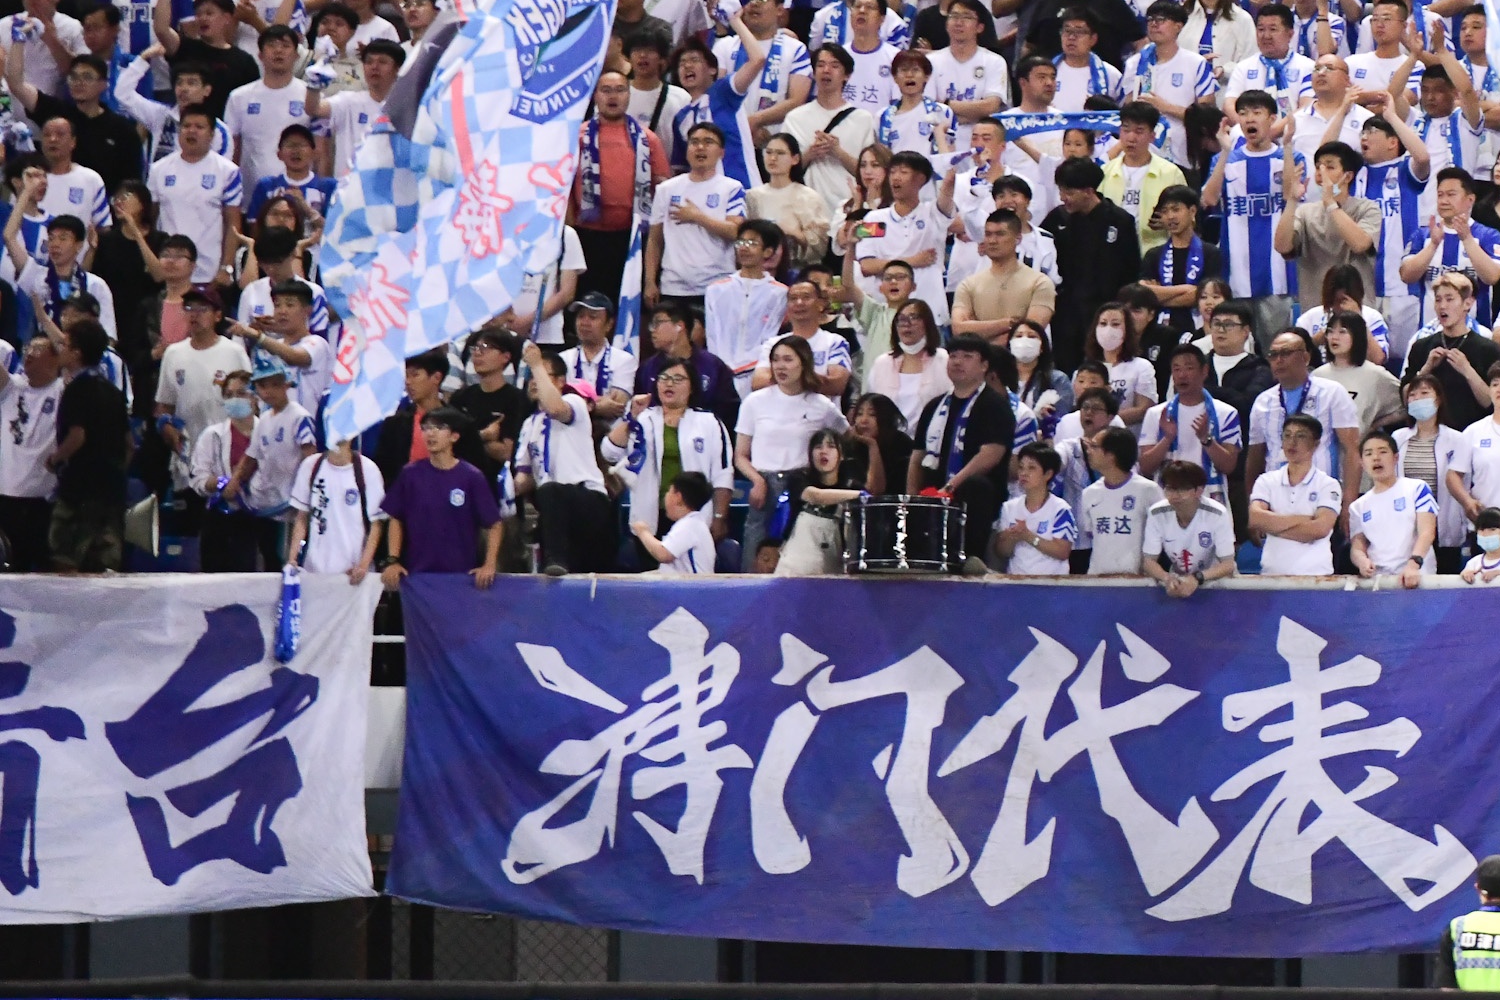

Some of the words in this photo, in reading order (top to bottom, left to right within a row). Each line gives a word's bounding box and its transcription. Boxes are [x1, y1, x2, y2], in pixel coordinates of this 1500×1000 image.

[1096, 514, 1132, 536] 泰达
[501, 606, 1479, 922] 津门代表
